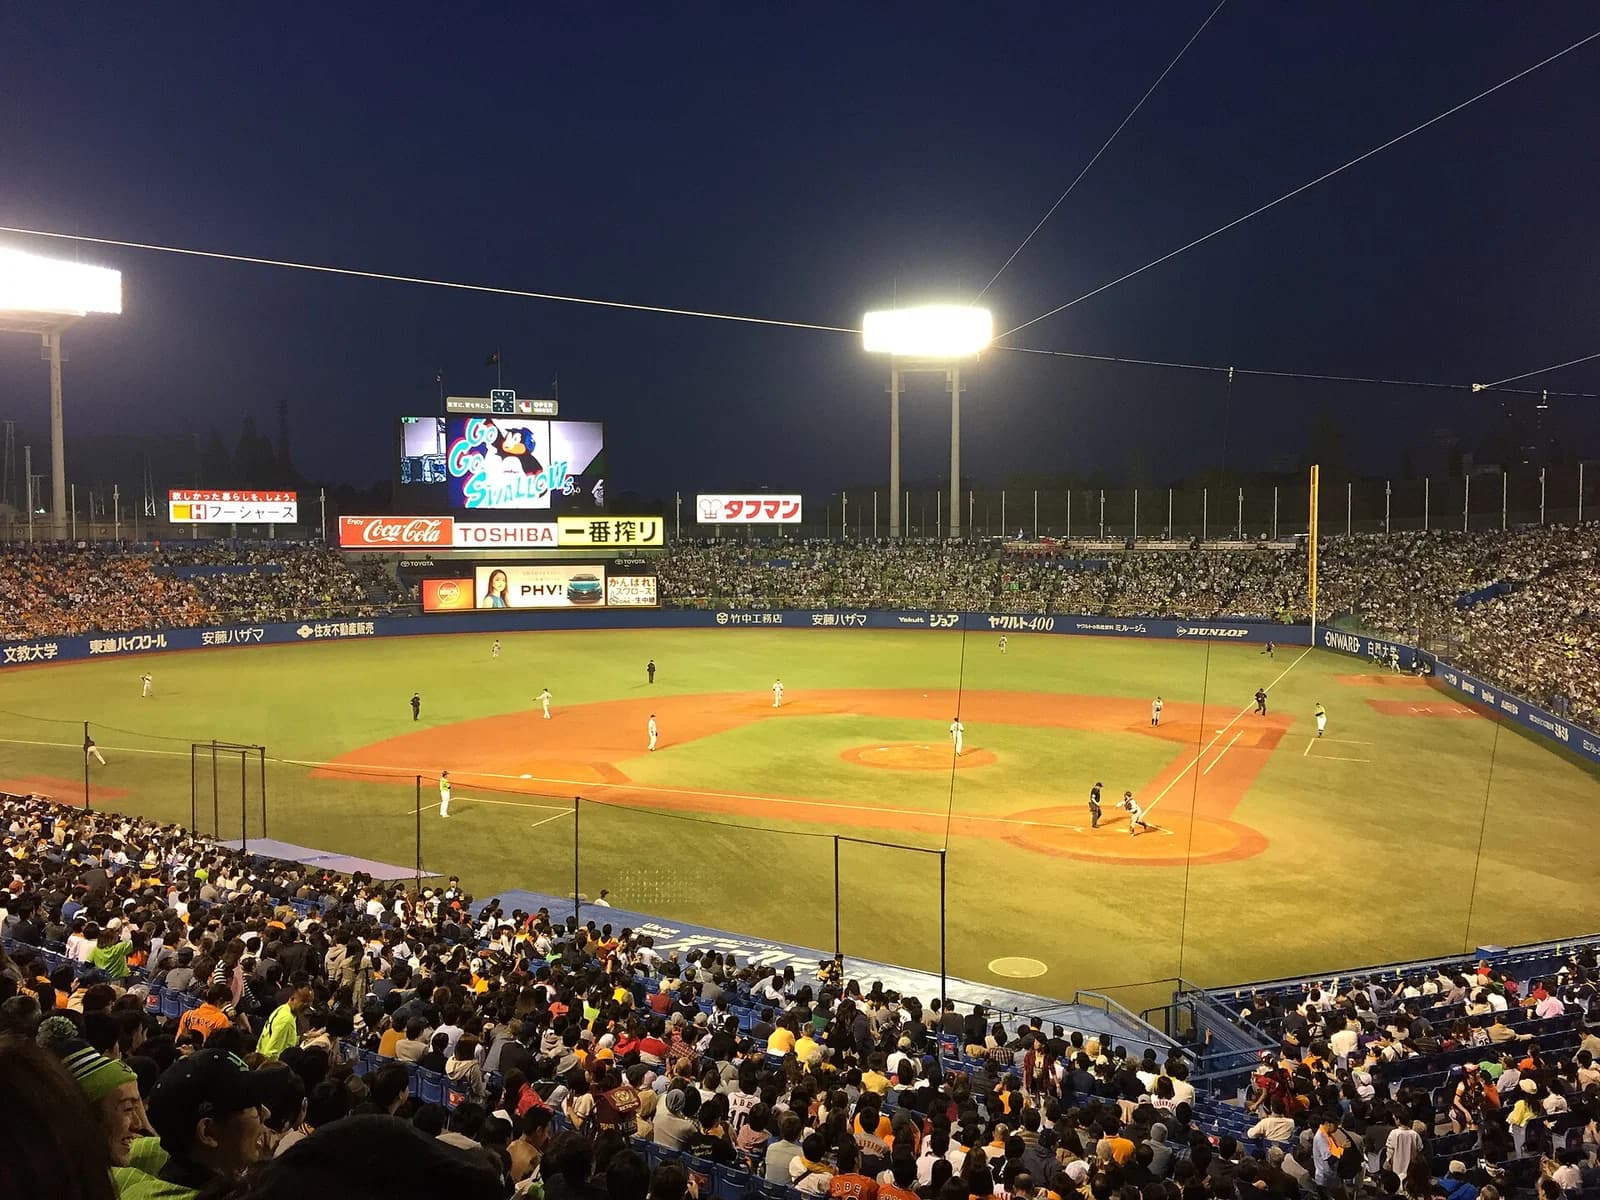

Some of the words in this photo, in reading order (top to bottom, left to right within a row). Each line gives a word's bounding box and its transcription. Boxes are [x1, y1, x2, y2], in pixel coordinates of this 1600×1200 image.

[210, 505, 294, 519] フーシャース
[724, 501, 799, 519] タフマン
[460, 527, 553, 542] TOSHIBA
[565, 521, 656, 542] 一番搾り
[521, 584, 562, 596] PHV!
[730, 613, 783, 624] 竹中工務店
[812, 613, 867, 626] 安藤ハザマ
[929, 614, 959, 627] ジョア
[988, 615, 1055, 631] ヤクルト400
[314, 622, 374, 637] 住友不動産販売
[1115, 623, 1147, 633] ミルージュ
[1188, 627, 1249, 638] DUNLOP
[89, 634, 167, 654] 東進ハイスクール
[201, 628, 265, 646] 安藤ハザマ
[1325, 631, 1361, 653] ONWARD
[3, 643, 58, 663] 文教大学
